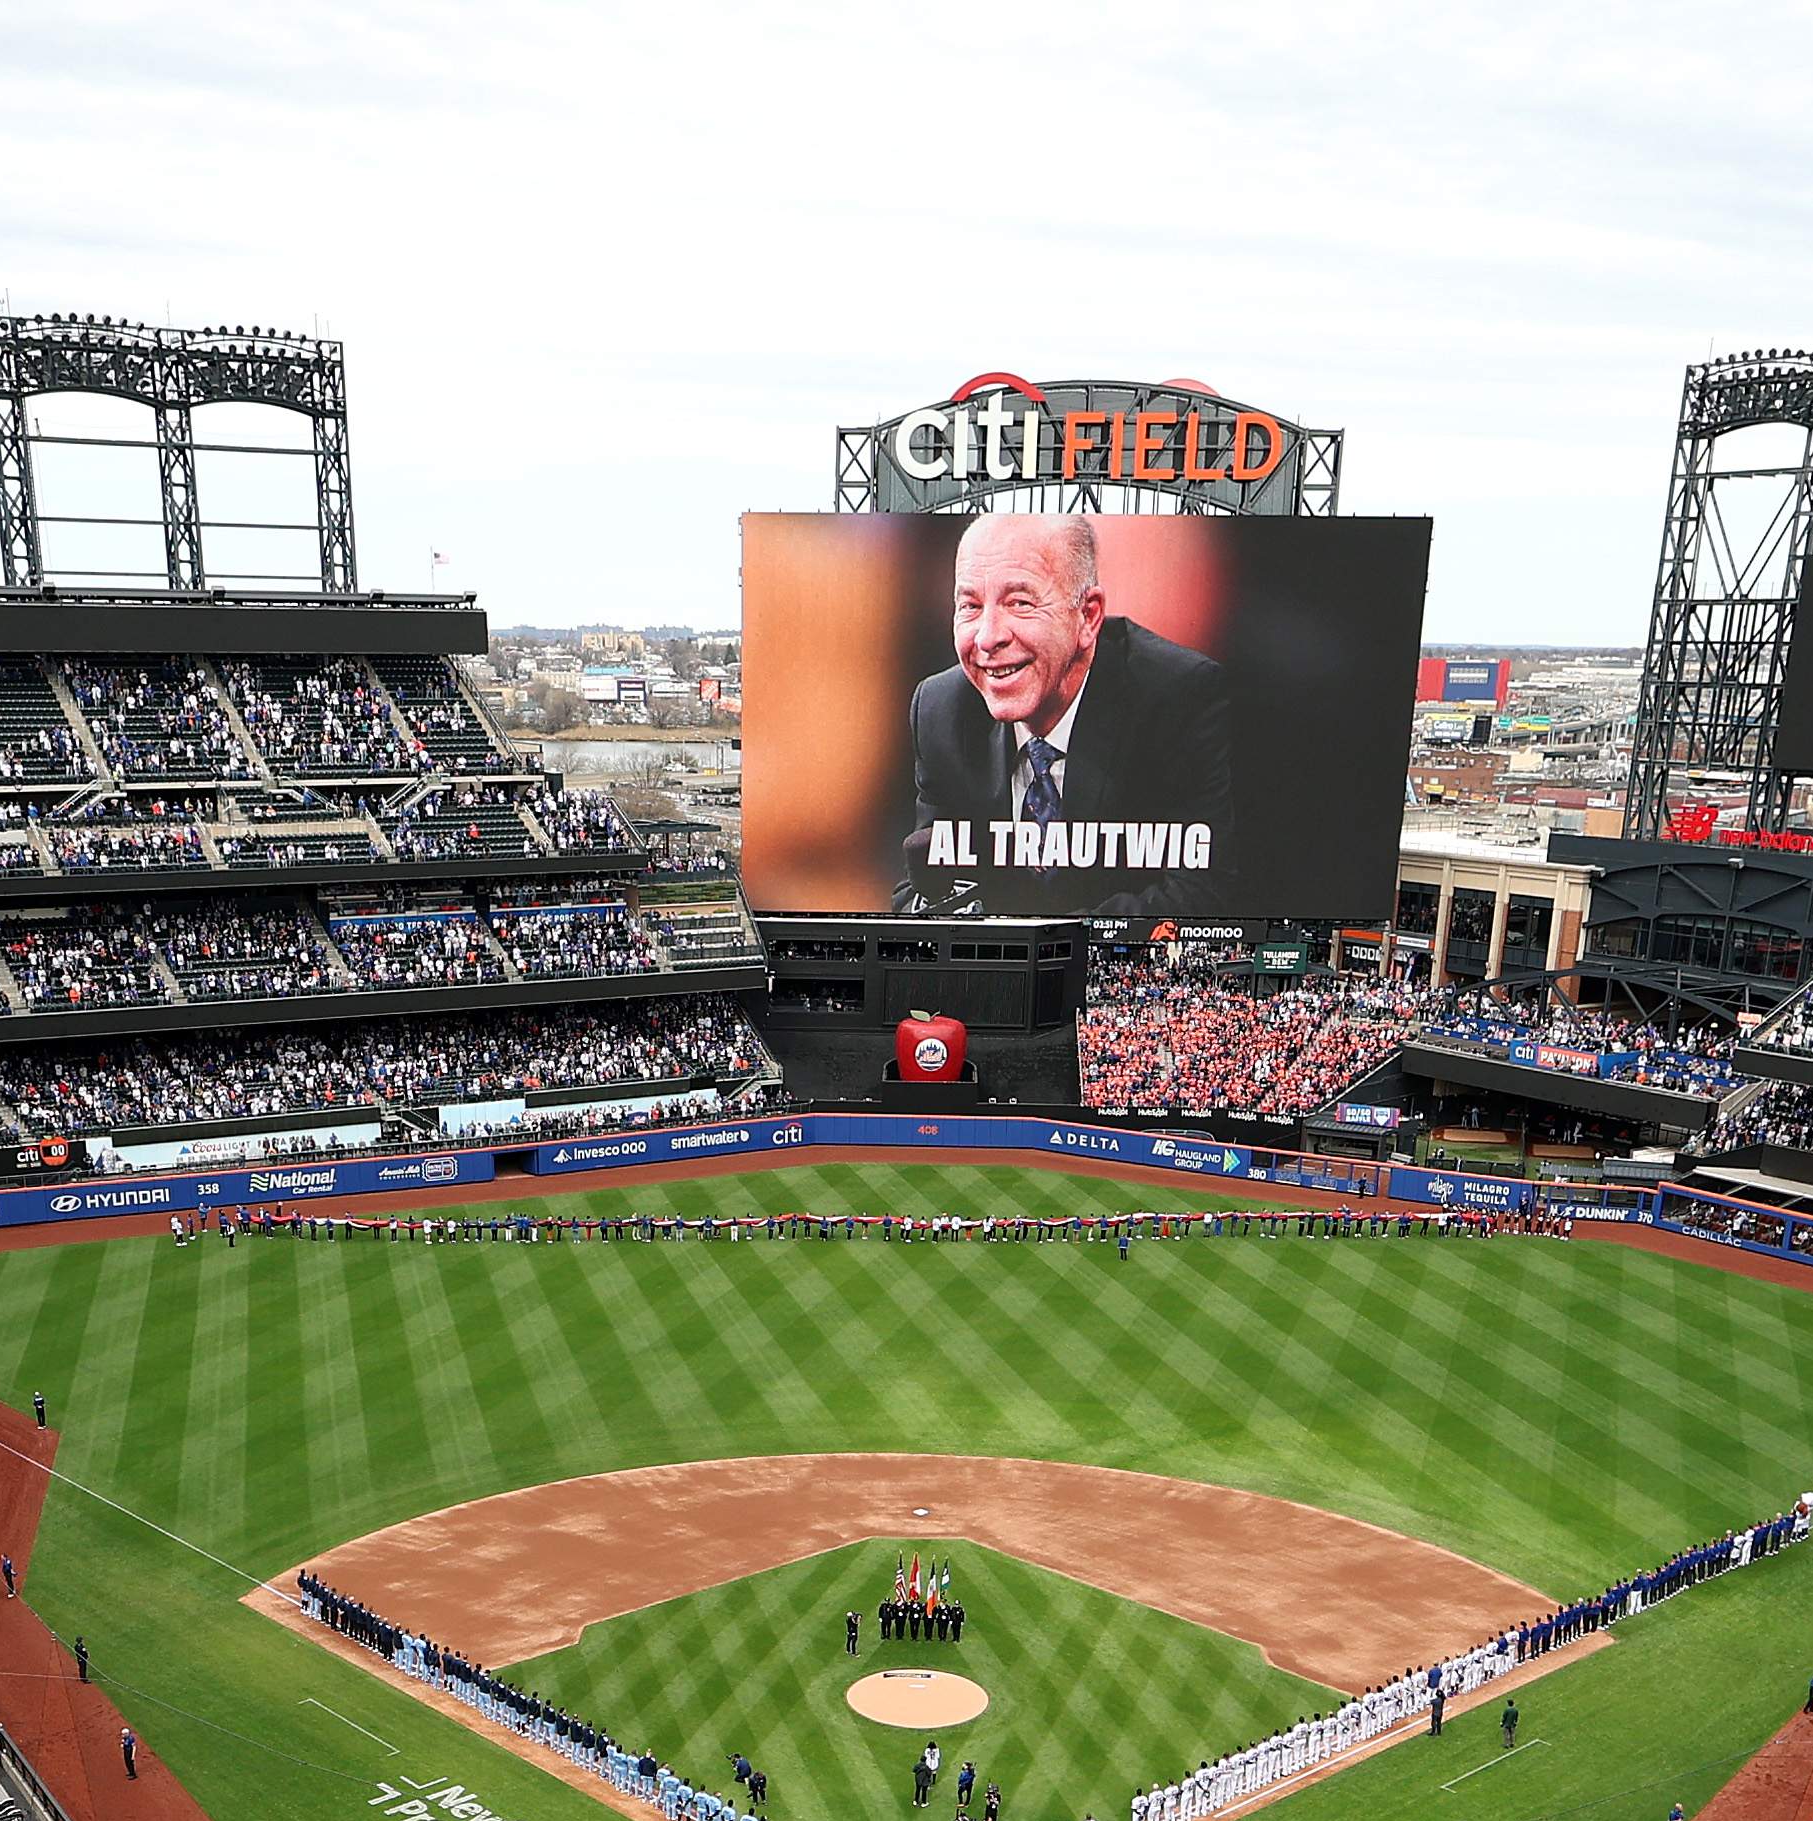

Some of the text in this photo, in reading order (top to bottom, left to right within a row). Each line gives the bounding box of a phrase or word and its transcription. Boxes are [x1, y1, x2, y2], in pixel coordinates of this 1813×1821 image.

[896, 391, 1283, 481] citi FIELD
[928, 819, 1211, 870] AL TRAUTWIG
[1719, 829, 1758, 845] new
[1115, 921, 1128, 930] PM
[1179, 925, 1243, 939] moomoo
[1262, 951, 1300, 959] TULLAMORE
[1515, 1044, 1535, 1061] citi
[772, 1126, 803, 1145] citi
[918, 1125, 938, 1136] 408
[671, 1131, 740, 1151] smartwater
[1067, 1133, 1119, 1152] DELTA
[16, 1149, 39, 1163] citi
[50, 1145, 65, 1157] 00
[574, 1140, 647, 1161] Invesco QQQ
[1175, 1149, 1221, 1165] HAUGLAND
[1174, 1157, 1203, 1170] GROUP
[1247, 1168, 1267, 1180] 380
[197, 1183, 220, 1195] 358
[292, 1184, 333, 1195] Car Rental
[1464, 1181, 1510, 1195] MILAGRO
[86, 1188, 170, 1210] HYUNDAI
[1464, 1192, 1507, 1206] TEQUILA
[1575, 1206, 1629, 1221] DUNKIN'
[1638, 1210, 1654, 1225] 370
[1682, 1226, 1742, 1248] CADILLAC
